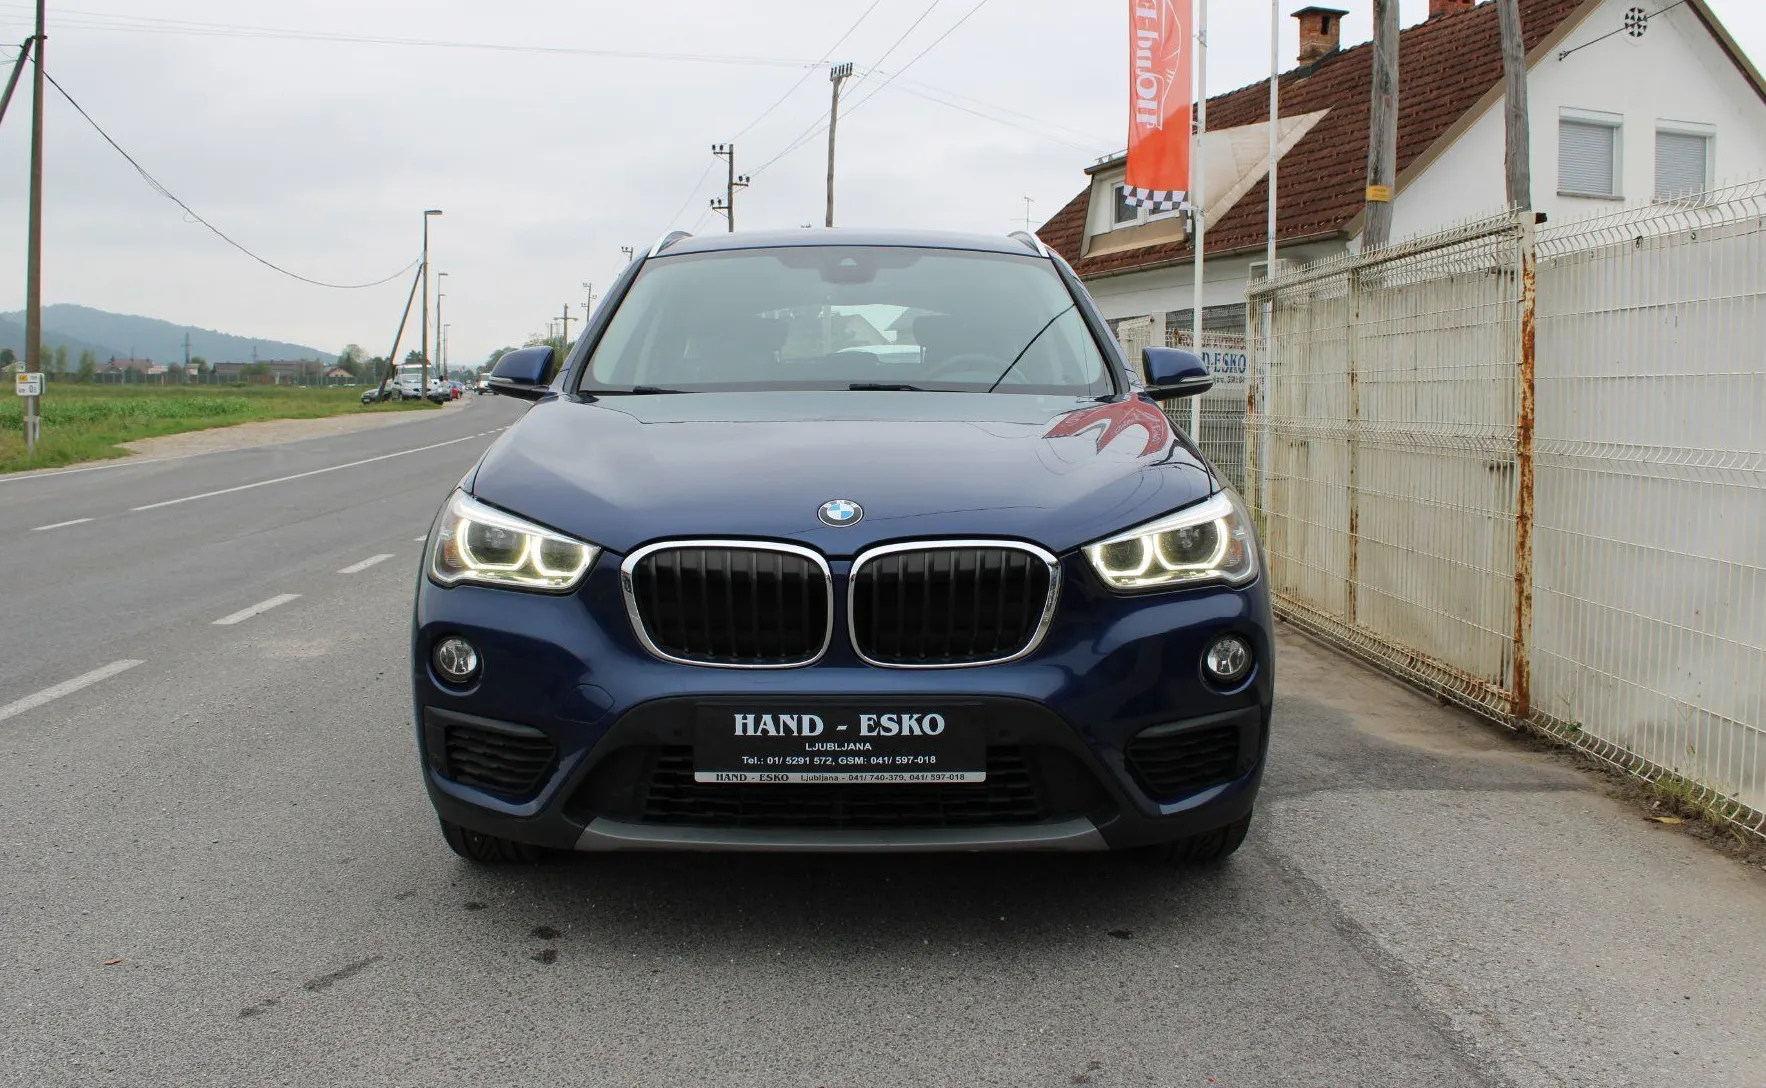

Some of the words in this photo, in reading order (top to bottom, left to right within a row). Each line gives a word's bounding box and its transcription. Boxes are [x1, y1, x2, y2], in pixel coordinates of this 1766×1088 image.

[734, 713, 824, 736] HAND
[859, 713, 946, 736] ESKO
[805, 742, 872, 751] LJUBLJANA
[742, 756, 764, 765] Tel.:
[767, 756, 783, 765] 01/
[785, 756, 810, 765] 5291
[813, 756, 836, 766] 572,
[838, 756, 868, 765] GSM:
[870, 756, 893, 765] 041/
[895, 755, 937, 764] 597-018
[716, 773, 748, 782] HAND
[759, 773, 790, 782] ESKO
[800, 774, 839, 783] Ljubljana
[909, 773, 929, 781] 041/
[930, 773, 965, 781] 597-018
